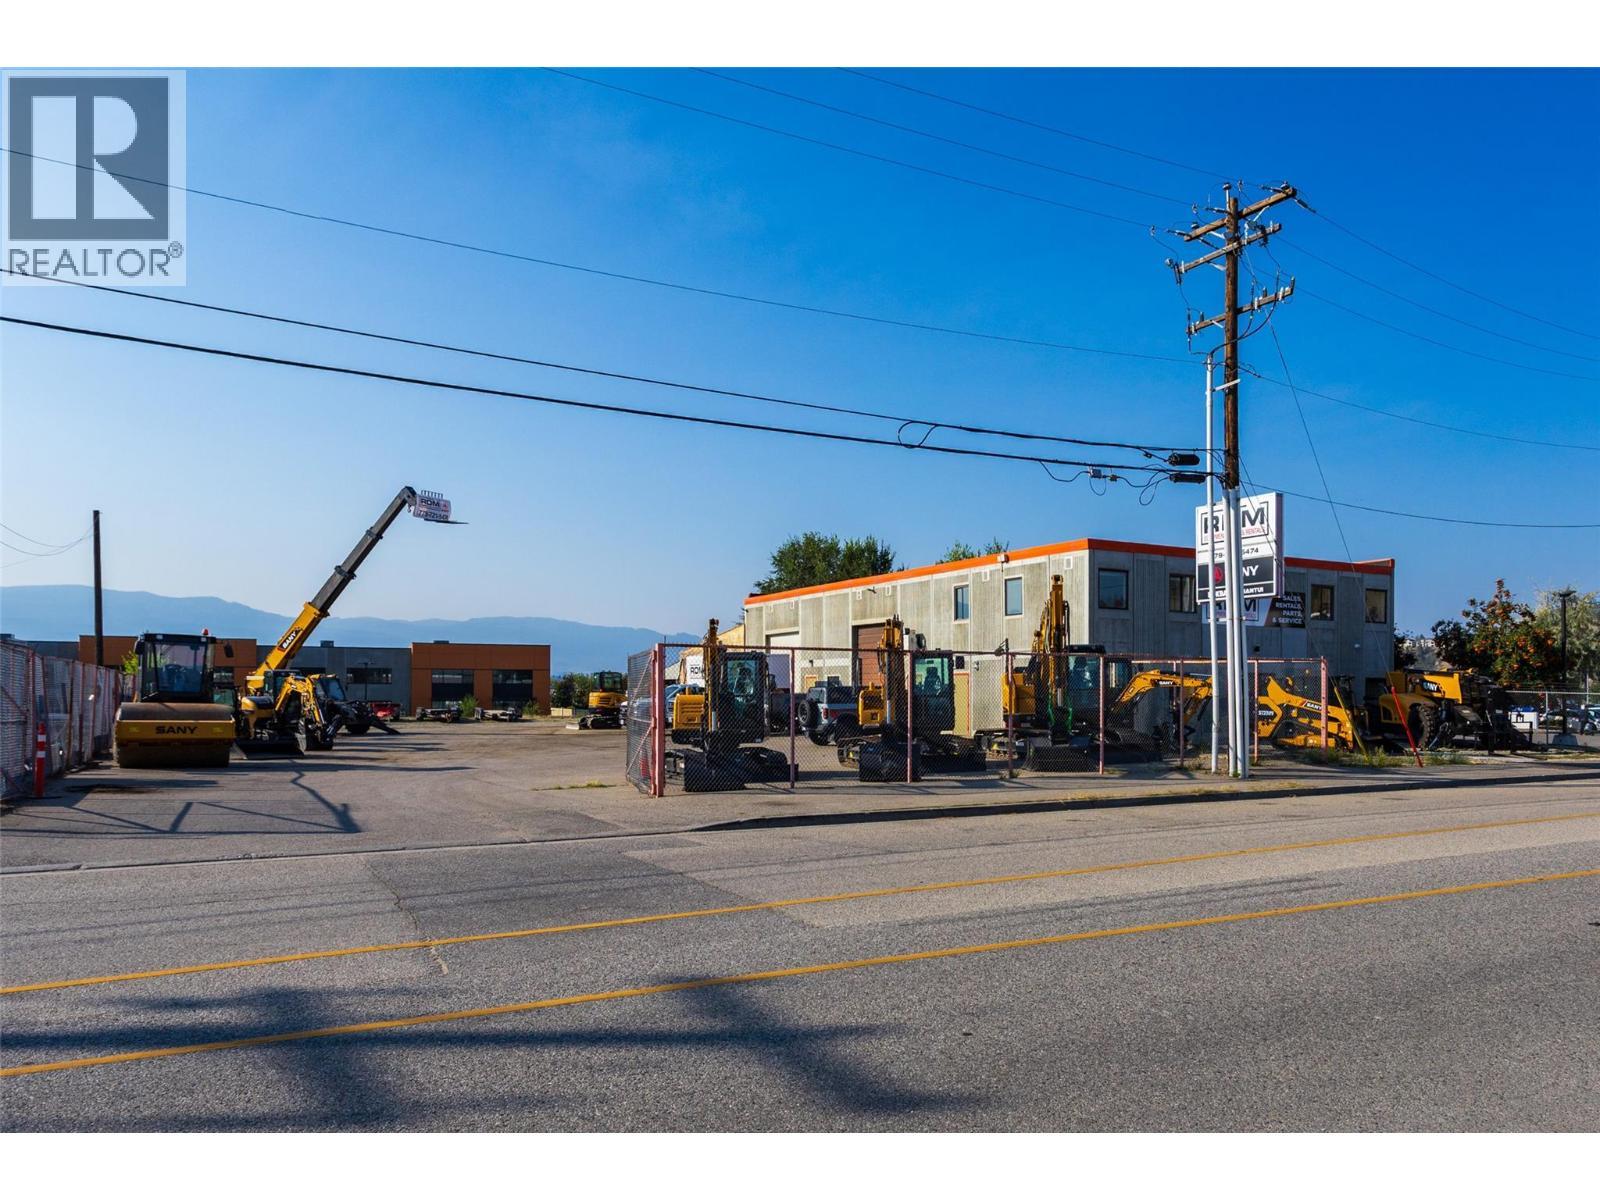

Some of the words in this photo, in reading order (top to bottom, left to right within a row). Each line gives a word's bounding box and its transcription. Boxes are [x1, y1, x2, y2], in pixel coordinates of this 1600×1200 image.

[1204, 507, 1265, 534] RM
[282, 631, 297, 649] SANY
[155, 725, 198, 734] SANY
